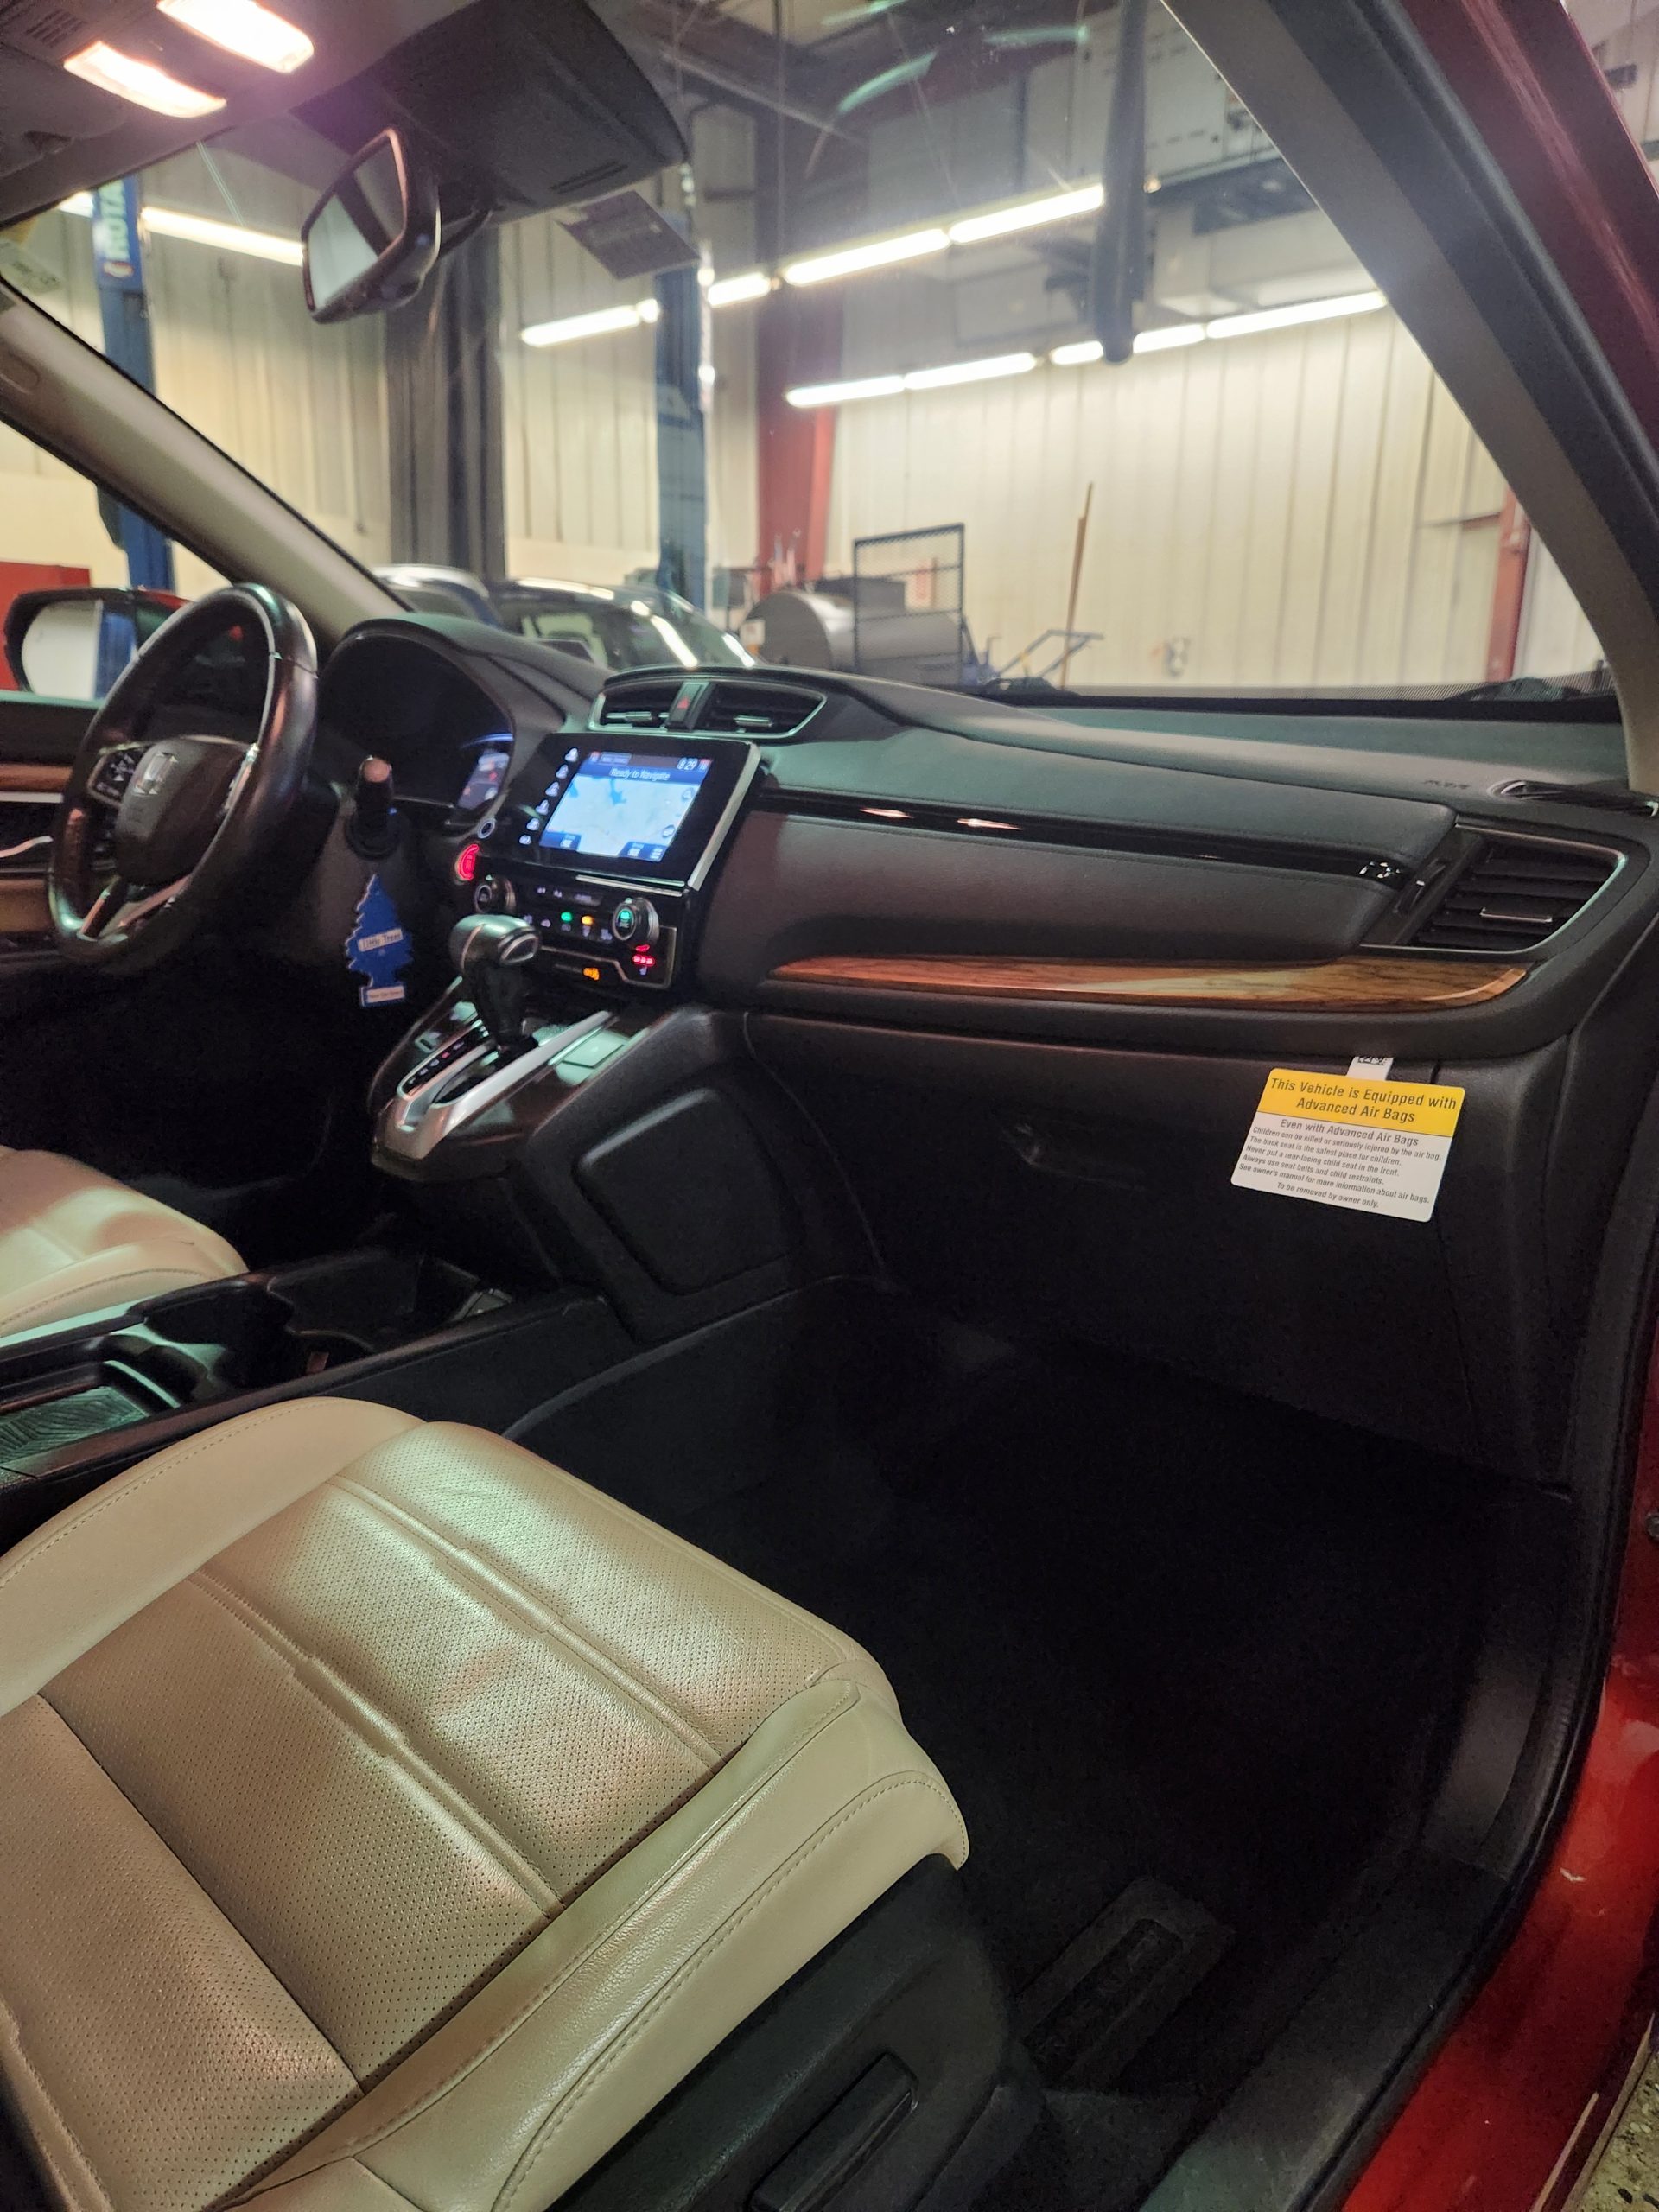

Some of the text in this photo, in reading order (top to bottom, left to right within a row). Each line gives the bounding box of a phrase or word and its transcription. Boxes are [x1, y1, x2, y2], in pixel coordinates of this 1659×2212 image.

[610, 767, 671, 781] Ready to Navigate
[1271, 1077, 1457, 1109] This Vehicle is Equipped with
[1296, 1097, 1415, 1123] Advanced Air Bags
[1253, 1127, 1281, 1136] Children
[1304, 1135, 1322, 1143] killed
[1332, 1140, 1363, 1150] seriously
[1365, 1144, 1389, 1154] injured
[1392, 1147, 1399, 1155] by
[1425, 1152, 1442, 1161] bag.
[1280, 1119, 1419, 1147] Even with Advanced Air Bags
[1242, 1154, 1268, 1165] Always
[1297, 1163, 1313, 1173] belts
[1330, 1170, 1347, 1179] child
[1348, 1173, 1384, 1185] restraints.
[1246, 1146, 1265, 1154] Never
[1285, 1152, 1321, 1165] rear-facing
[1323, 1158, 1340, 1167] child
[1342, 1161, 1357, 1170] seat
[1380, 1166, 1399, 1176] front.
[1316, 1147, 1338, 1156] safest
[1370, 1154, 1401, 1166] children.
[1253, 1166, 1278, 1176] owner's
[1279, 1172, 1305, 1180] manual
[1336, 1180, 1375, 1193] information
[1376, 1188, 1397, 1198] about
[1398, 1192, 1408, 1200] air
[1410, 1193, 1429, 1204] bags.
[1296, 1187, 1327, 1198] removed
[1328, 1192, 1338, 1201] by
[1338, 1196, 1361, 1205] owner
[1362, 1198, 1379, 1208] only.
